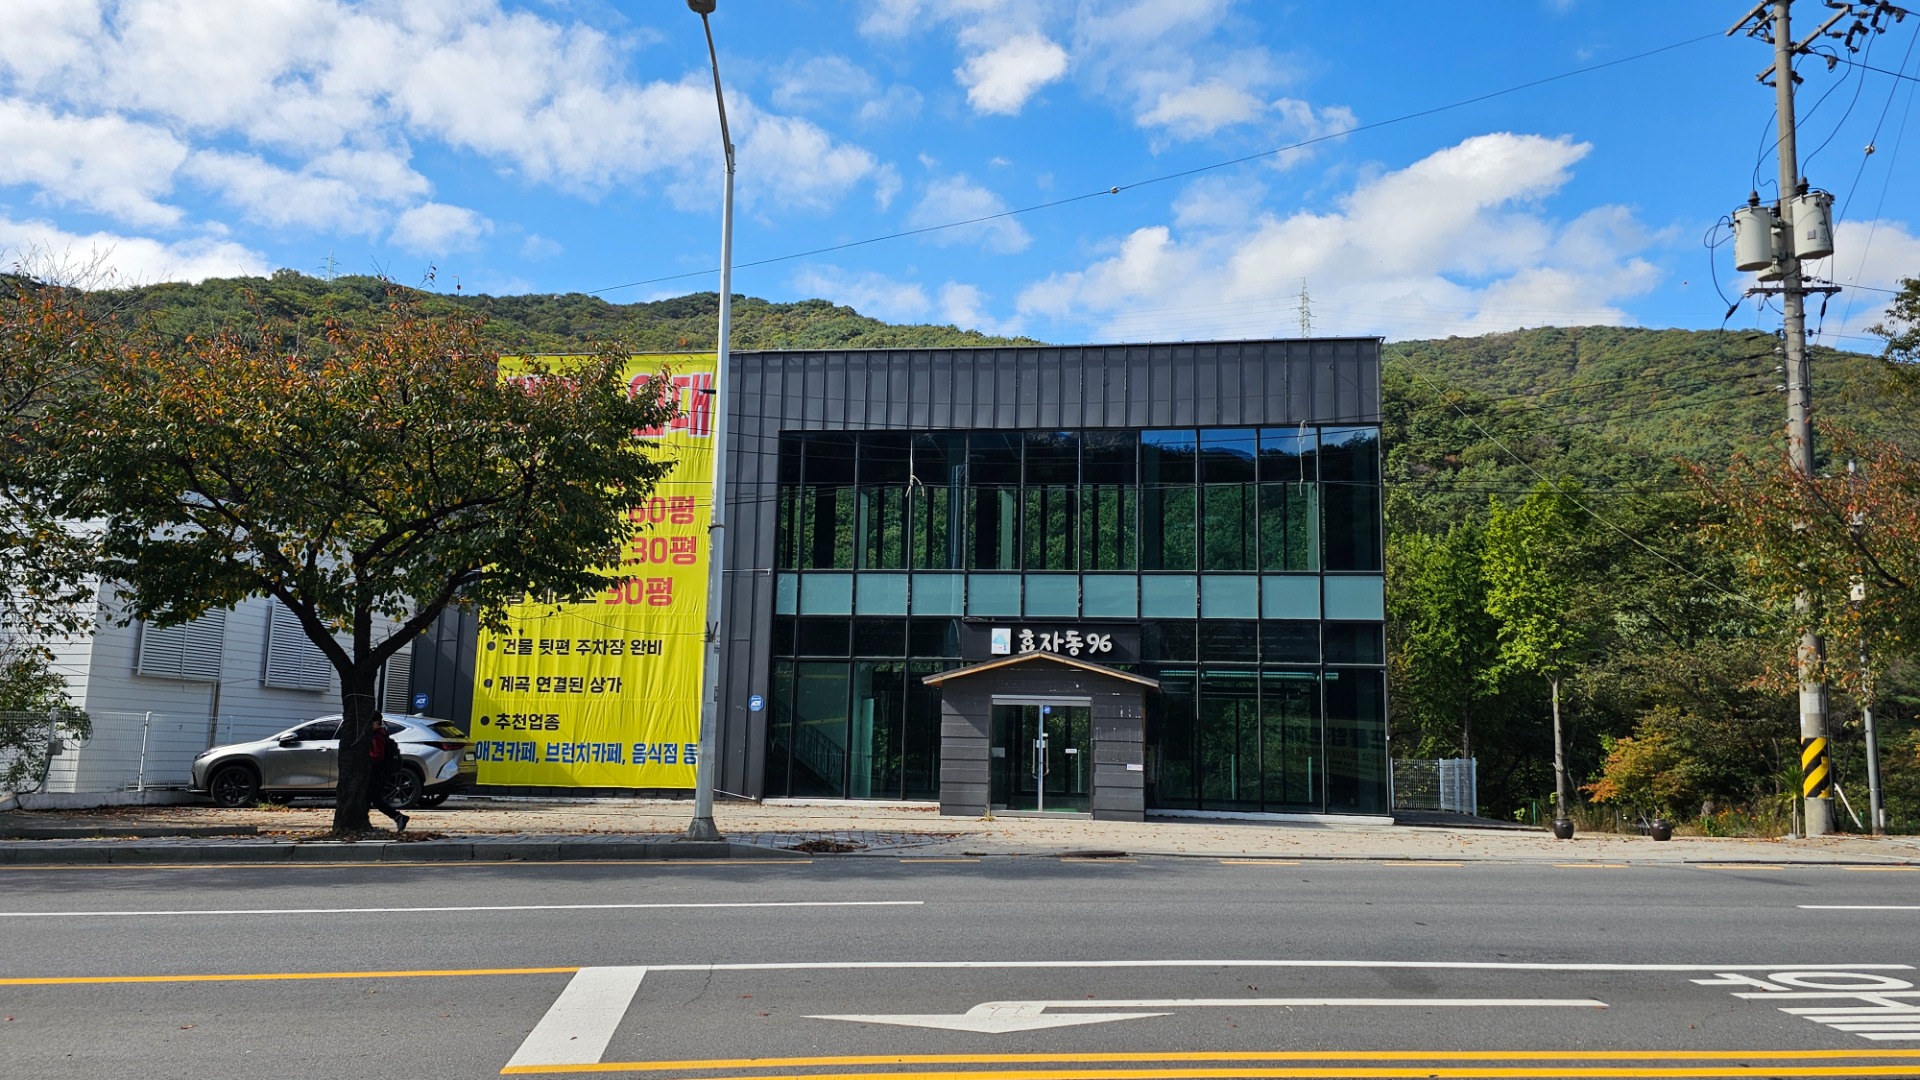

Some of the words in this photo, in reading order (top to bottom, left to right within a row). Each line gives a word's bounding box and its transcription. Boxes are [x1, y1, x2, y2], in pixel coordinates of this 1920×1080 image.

[629, 536, 696, 564] 30평
[502, 638, 533, 655] 건물
[539, 639, 570, 655] 뒷편
[576, 639, 625, 655] 주차장
[630, 640, 662, 656] 완비
[1018, 628, 1113, 656] 효자동96
[499, 676, 530, 693] 계곡
[536, 676, 584, 693] 연결된
[590, 676, 622, 693] 상가
[495, 713, 560, 730] 추천업종
[476, 740, 540, 764] 애견카페,
[545, 741, 626, 766] 브런치카페,
[632, 743, 677, 764] 음식점
[683, 743, 698, 765] 등
